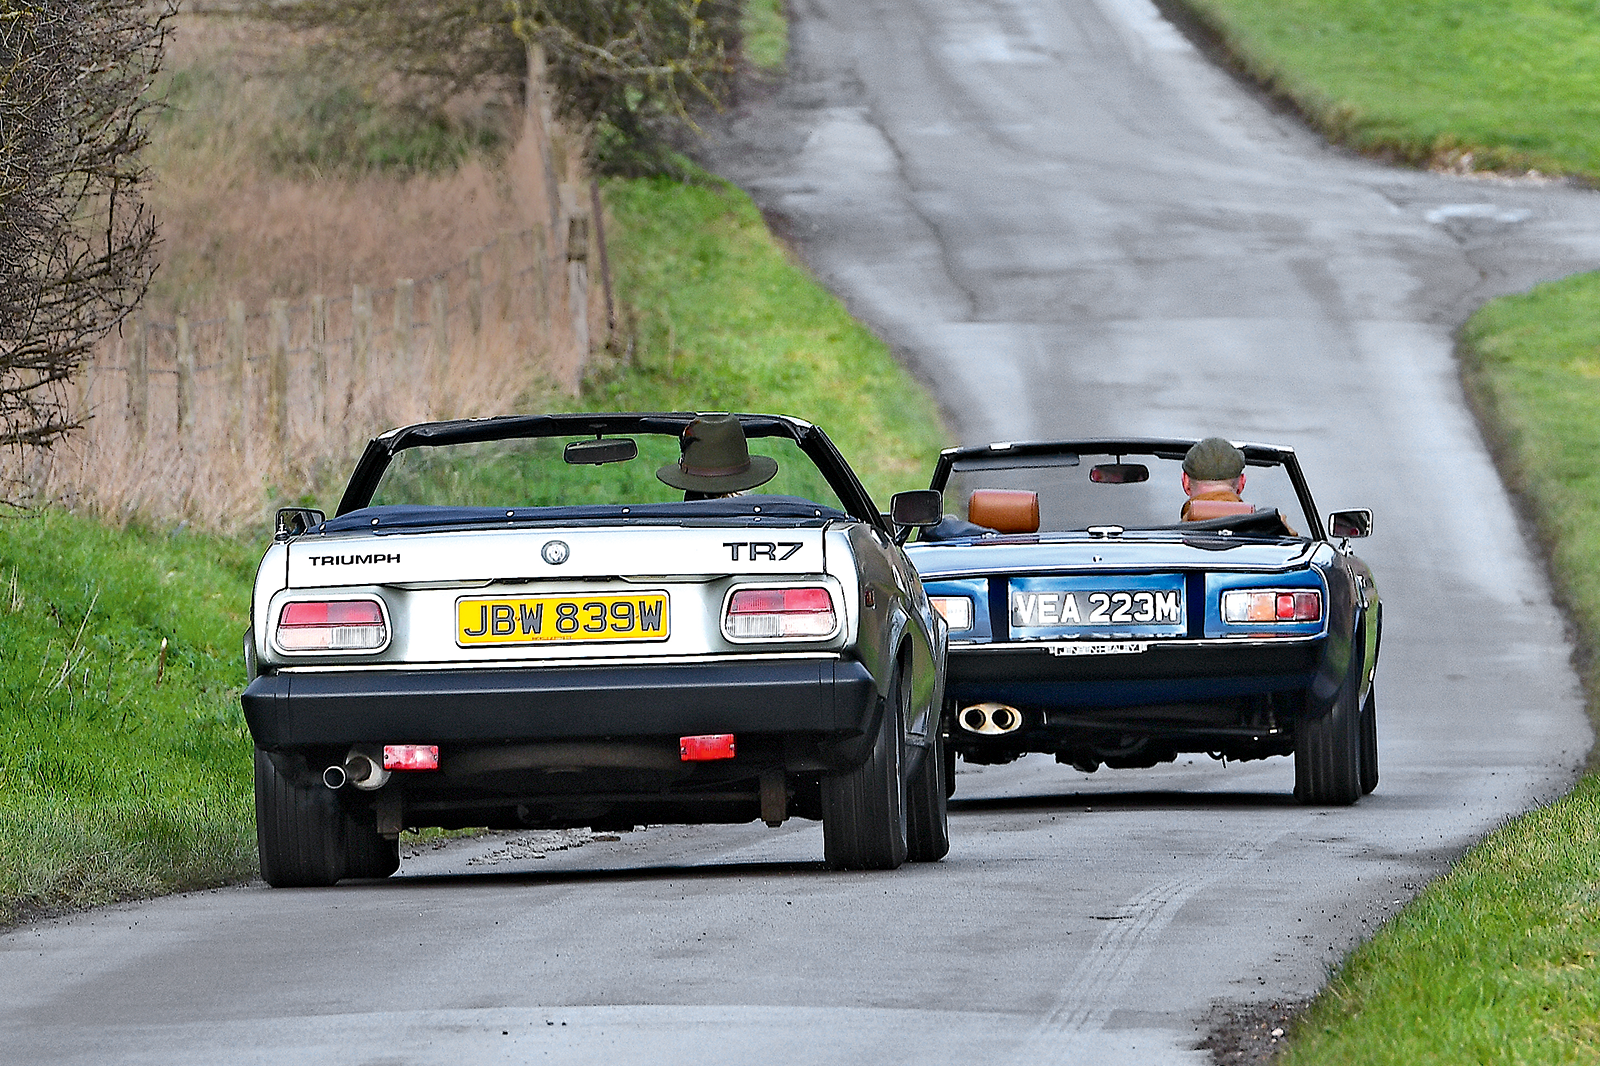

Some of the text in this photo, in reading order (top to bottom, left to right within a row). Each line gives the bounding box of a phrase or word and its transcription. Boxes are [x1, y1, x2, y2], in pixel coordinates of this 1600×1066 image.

[308, 553, 401, 566] TRIUMPH
[722, 541, 804, 561] TR7
[1015, 591, 1179, 624] VEA 223M
[464, 600, 663, 637] JBW 839W
[1059, 643, 1138, 655] JNN-HALY
